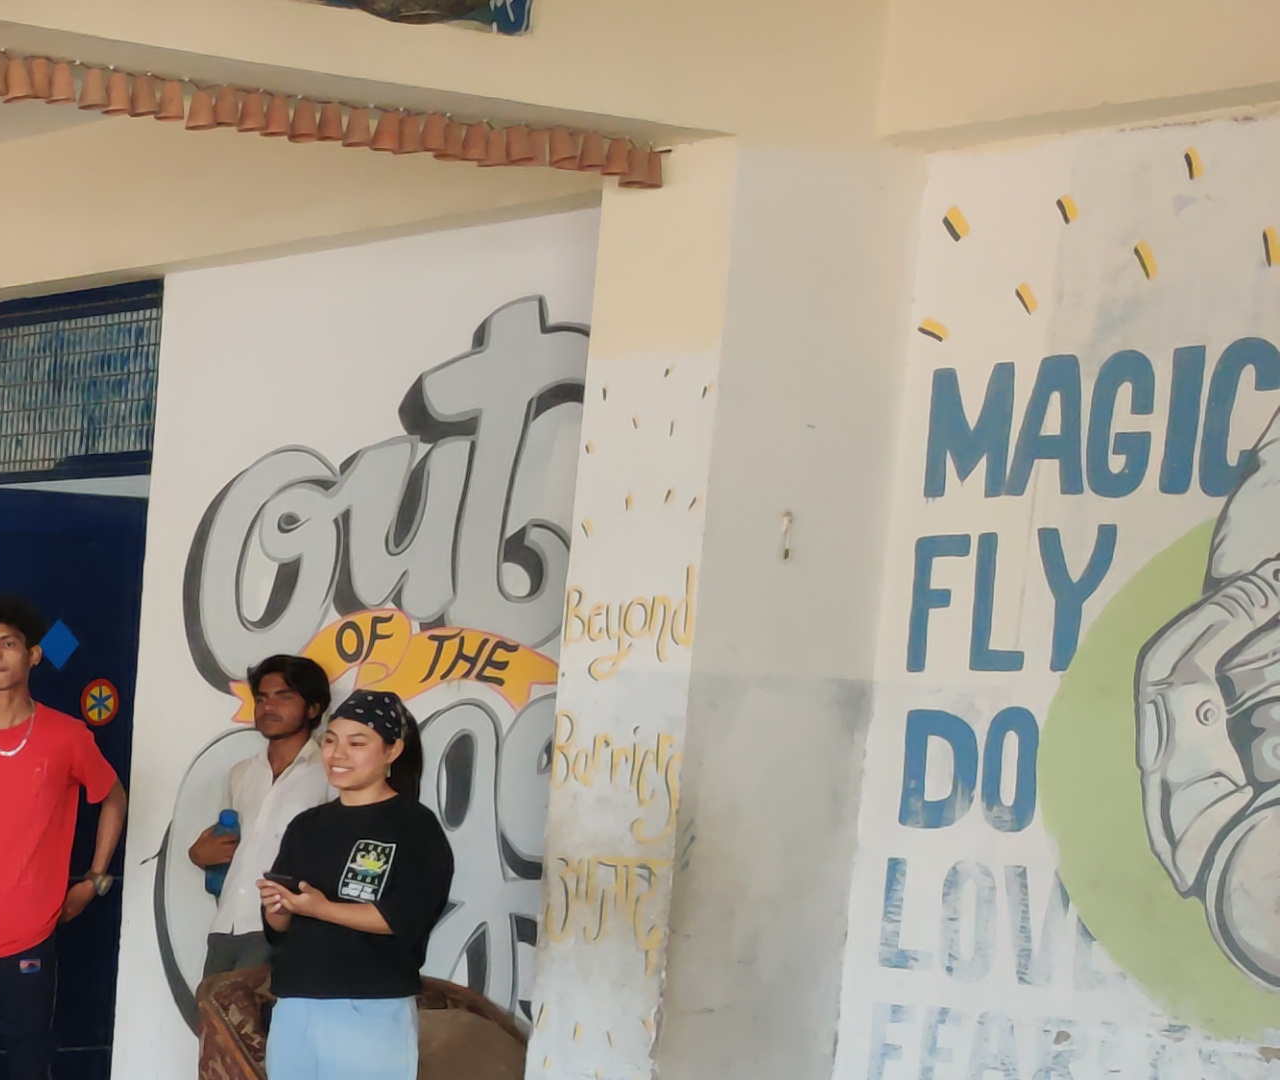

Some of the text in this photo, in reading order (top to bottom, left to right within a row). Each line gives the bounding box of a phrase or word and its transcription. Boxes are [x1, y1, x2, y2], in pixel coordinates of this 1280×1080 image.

[923, 337, 1280, 498] MAGIC
[335, 614, 520, 687] OF THE
[905, 523, 1117, 673] FLY
[898, 705, 1040, 832] DO
